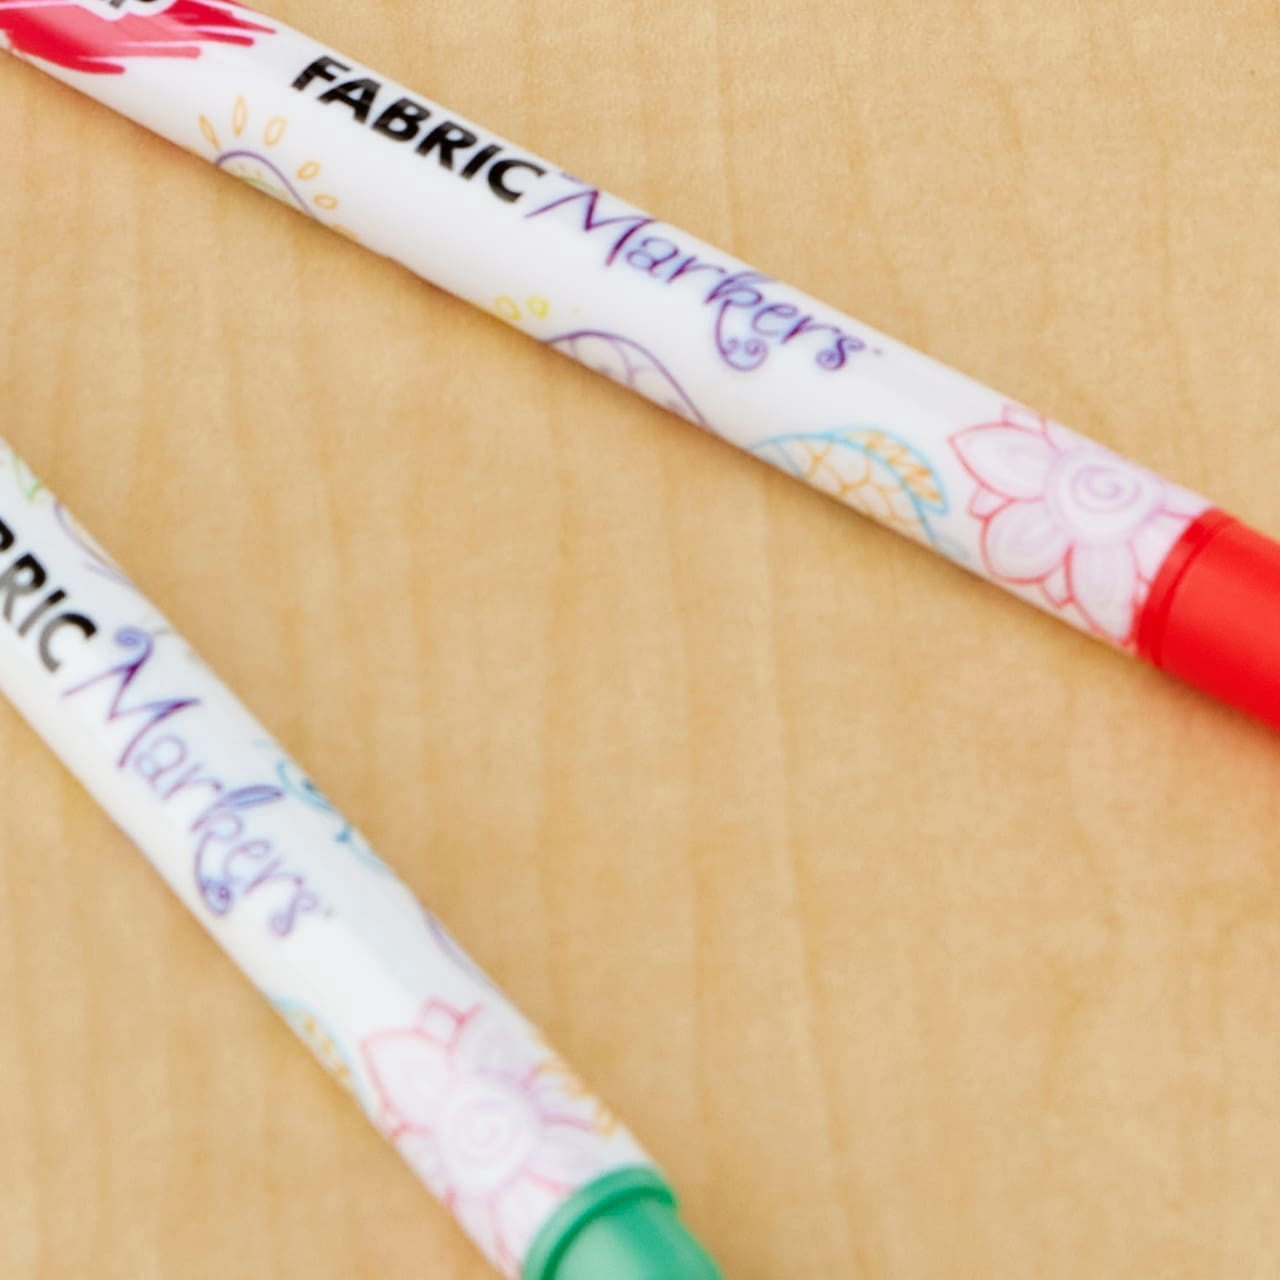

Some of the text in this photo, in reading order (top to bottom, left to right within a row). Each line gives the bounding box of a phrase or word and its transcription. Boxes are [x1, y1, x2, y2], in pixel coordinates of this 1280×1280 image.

[289, 53, 548, 204] FABRIC
[524, 173, 866, 373] Markers
[65, 626, 321, 936] Markers
